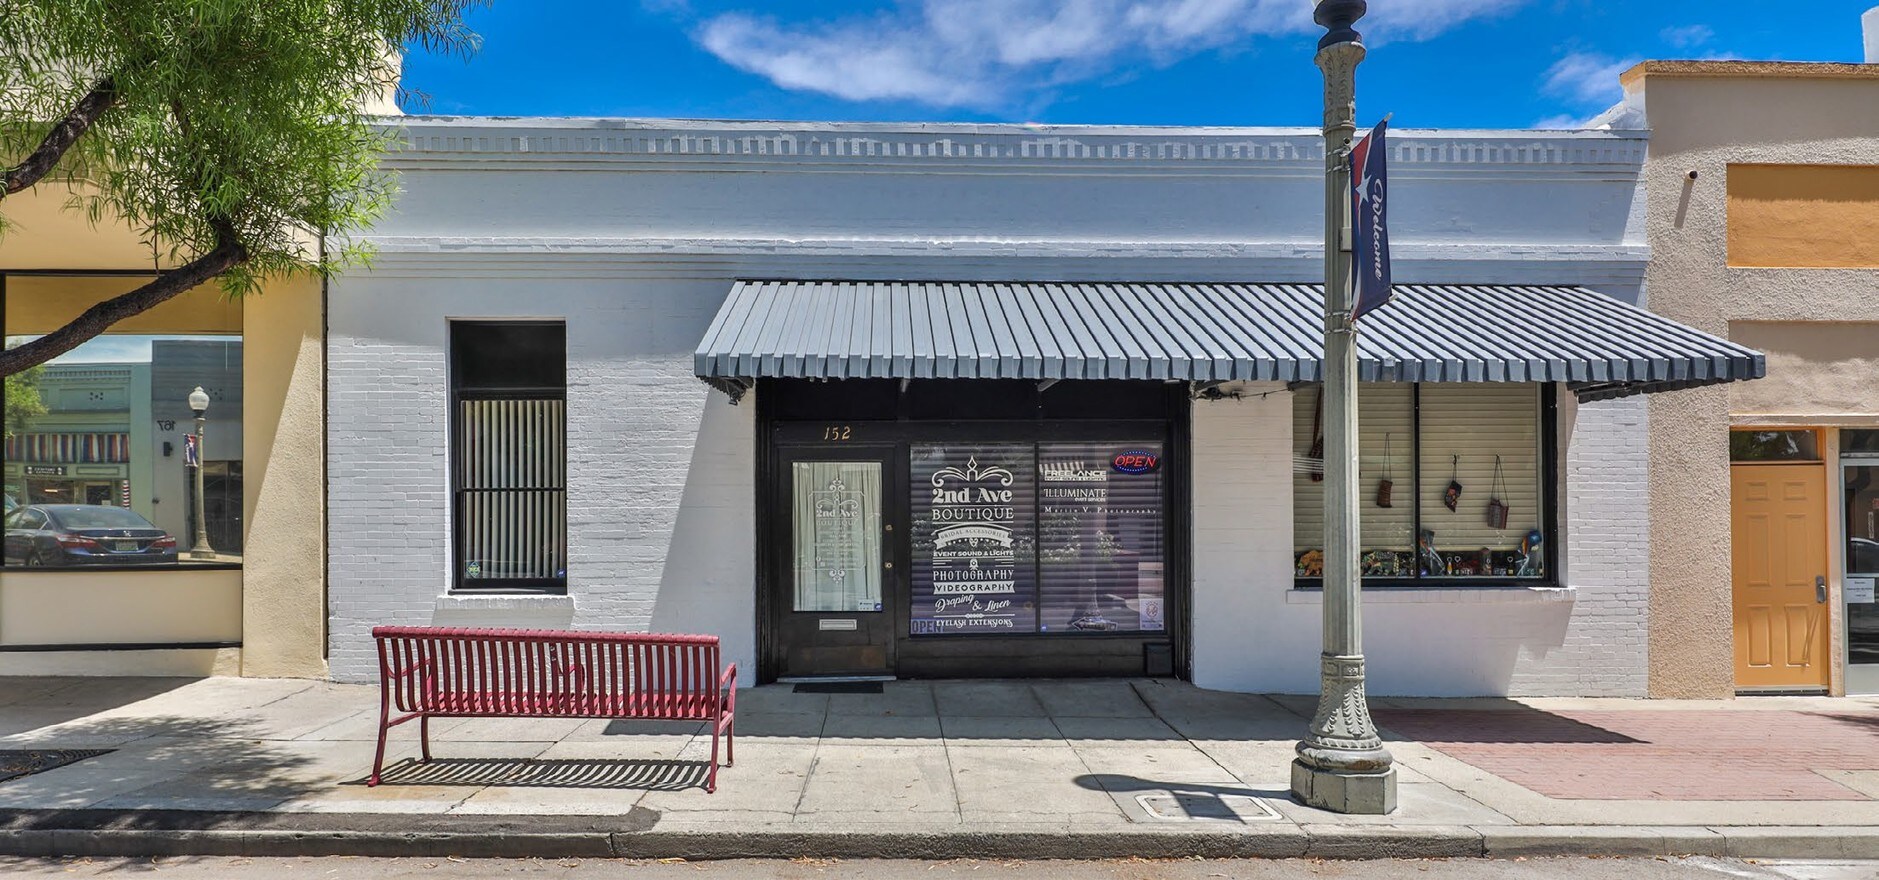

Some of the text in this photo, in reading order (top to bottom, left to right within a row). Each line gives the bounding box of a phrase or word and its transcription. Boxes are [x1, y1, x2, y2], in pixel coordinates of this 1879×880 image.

[1371, 178, 1384, 281] Welcome
[824, 426, 851, 440] 152
[1114, 455, 1157, 468] OPEN
[932, 487, 1013, 504] 2nd Ave
[816, 508, 858, 518] 2nd Ave
[932, 508, 1014, 521] BOUTIQUE
[940, 528, 962, 539] BRIDAL
[933, 570, 1015, 580] PHOTOGRAPHY
[936, 584, 1012, 592] VIDEOGRAPHY
[934, 594, 1011, 613] Draping & Linen
[911, 620, 945, 633] OPEN
[936, 619, 1014, 628] EYELASH EXTENSIONS
